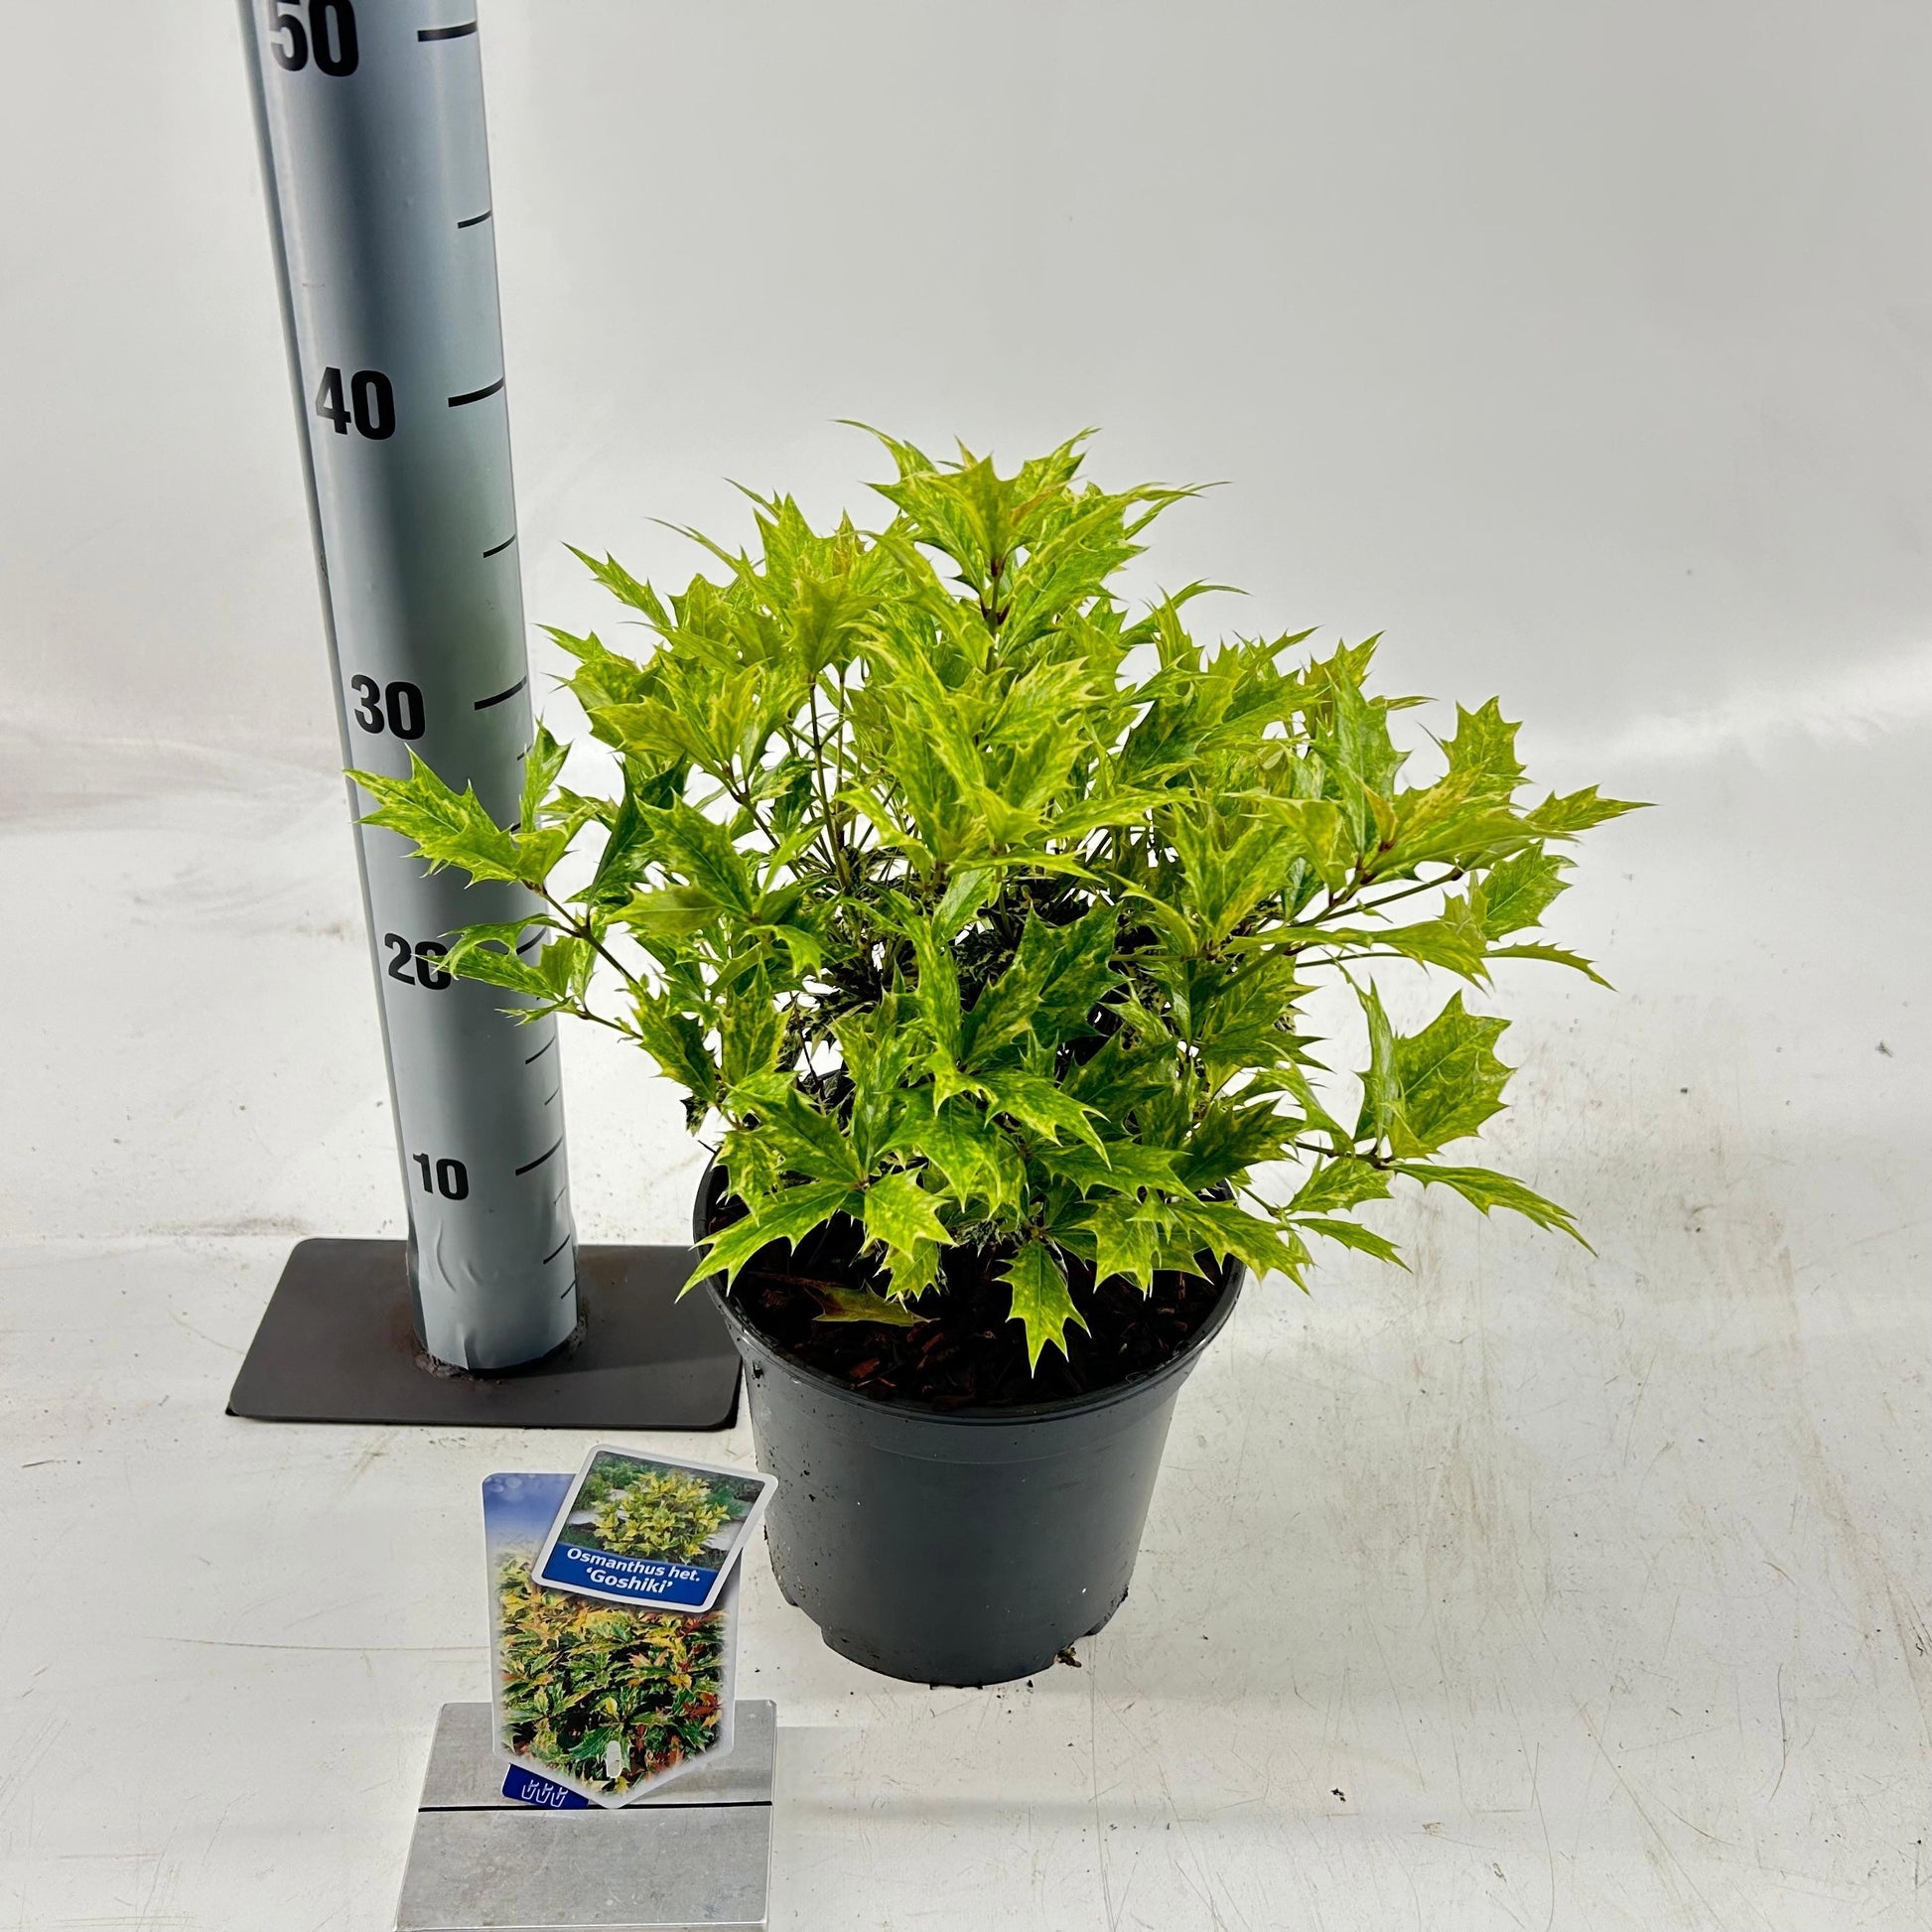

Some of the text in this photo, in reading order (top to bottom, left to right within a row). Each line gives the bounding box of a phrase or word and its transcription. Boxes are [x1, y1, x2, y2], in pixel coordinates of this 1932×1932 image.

[269, 0, 359, 77] 50
[315, 366, 396, 441] 40
[350, 674, 426, 740] 30
[384, 933, 452, 990] 20
[412, 1153, 470, 1201] 10
[567, 1548, 701, 1583] Osmanthus het.
[586, 1567, 674, 1594] ‘Goshiki’
